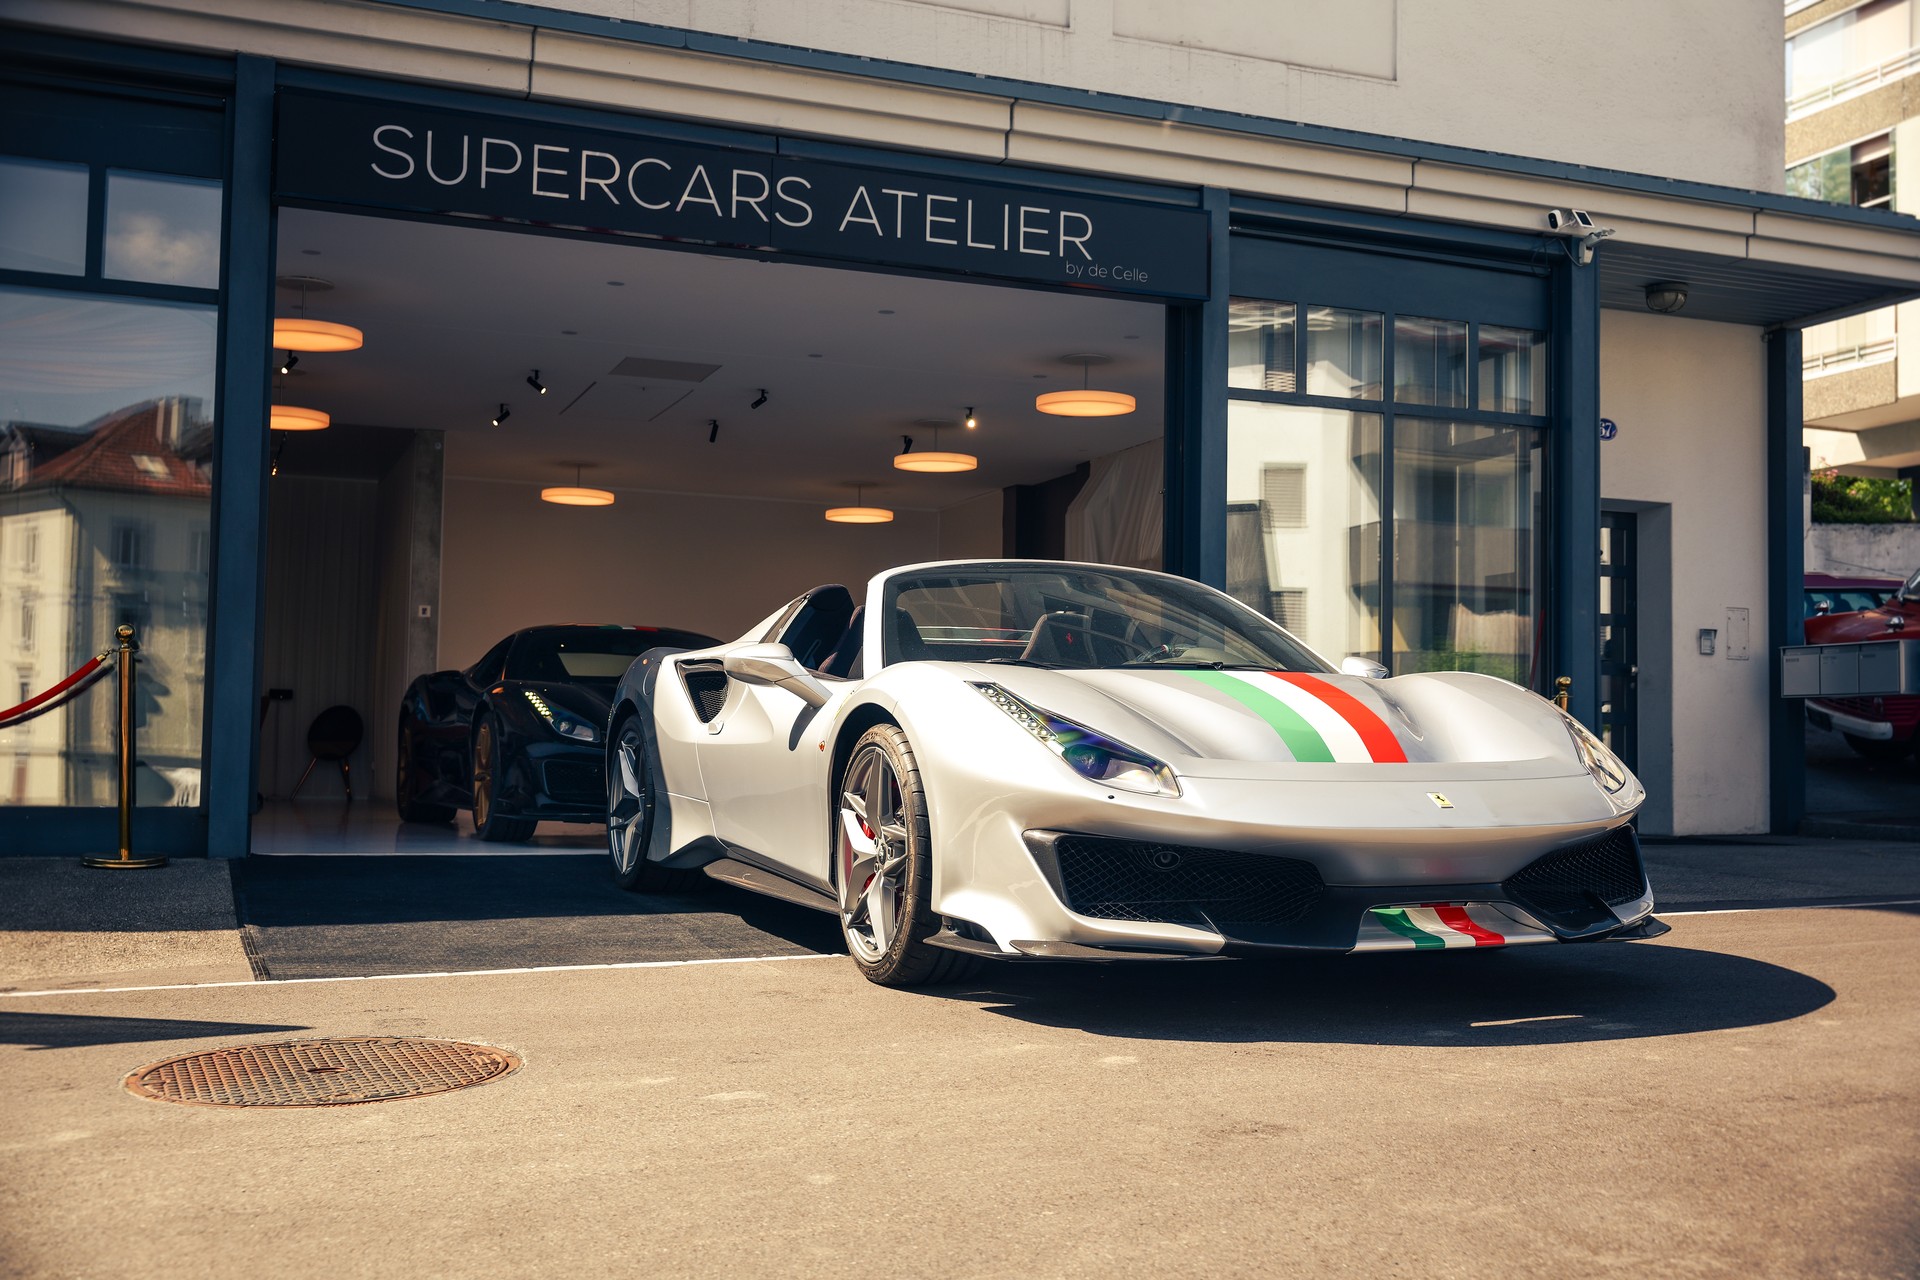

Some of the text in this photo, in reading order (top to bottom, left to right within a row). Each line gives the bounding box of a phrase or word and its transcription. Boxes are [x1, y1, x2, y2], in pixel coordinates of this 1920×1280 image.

[371, 125, 1093, 261] SUPERCARS ATELIER
[1066, 260, 1148, 283] by de Celle
